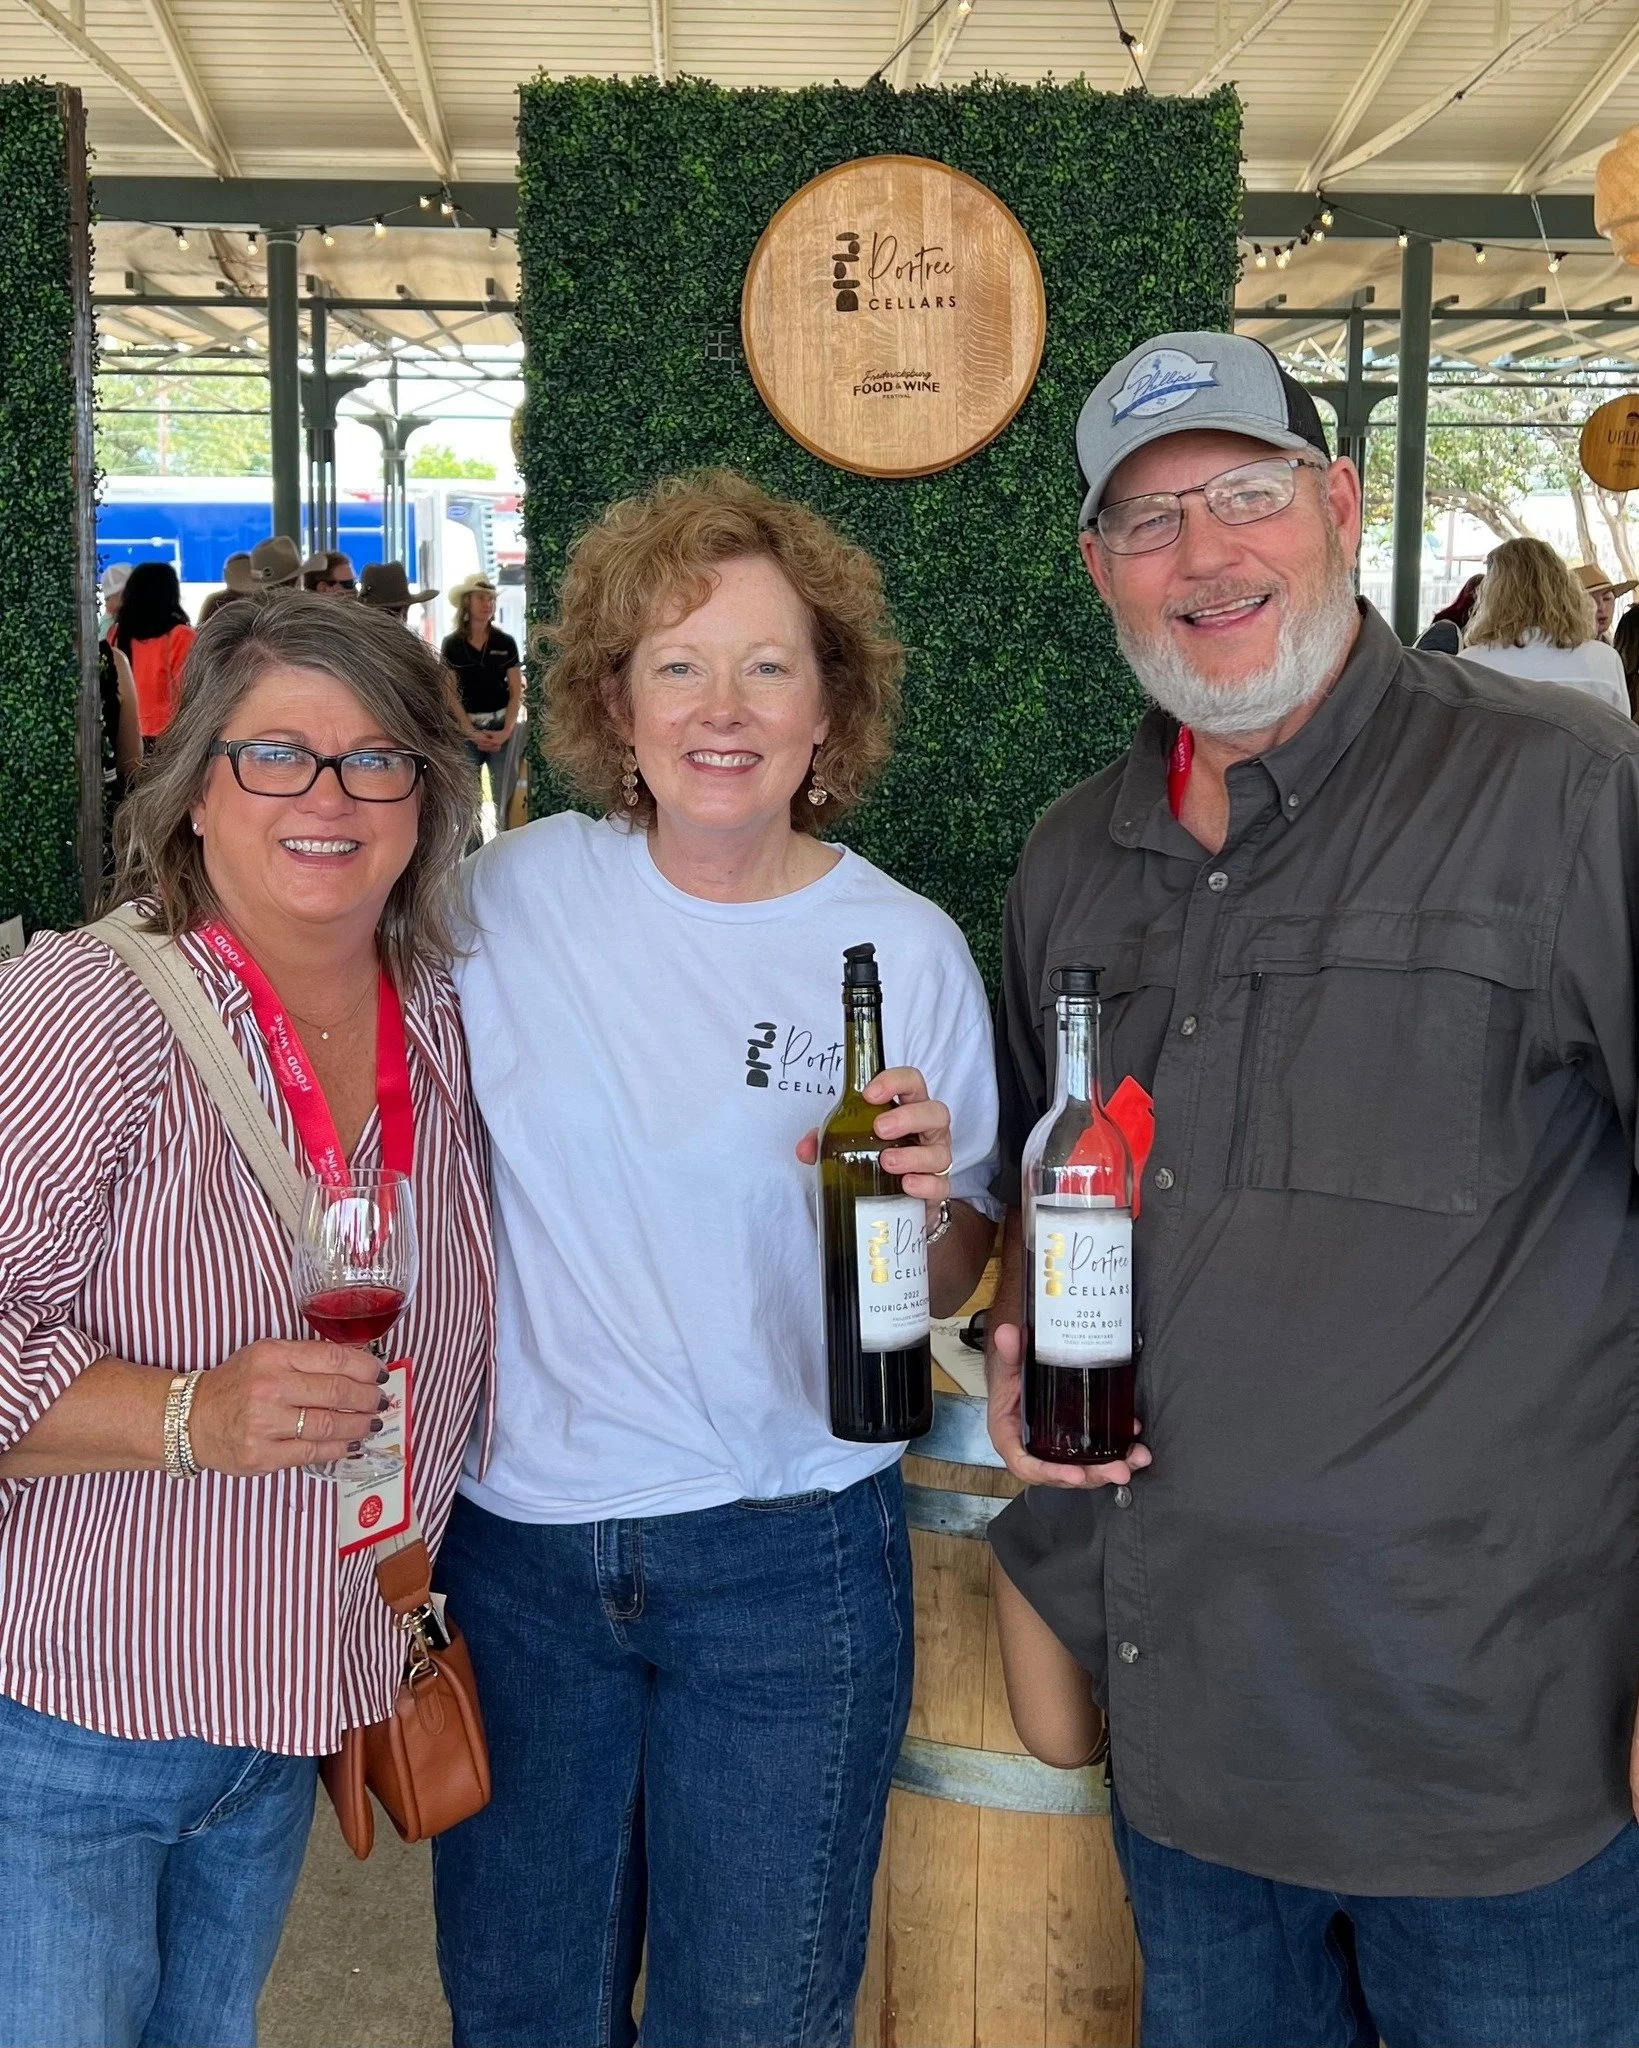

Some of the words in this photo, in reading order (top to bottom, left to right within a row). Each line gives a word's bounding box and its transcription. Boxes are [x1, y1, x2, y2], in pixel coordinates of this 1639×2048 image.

[868, 232, 955, 296] Portree
[869, 296, 956, 310] CELLARS
[853, 382, 893, 396] FOOD
[903, 381, 940, 393] WINE
[1127, 369, 1197, 402] Phillips
[214, 935, 246, 968] FOOD
[274, 1012, 289, 1050] WINE
[287, 1056, 312, 1092] FOOD
[778, 1081, 836, 1096] CELLA
[325, 1145, 341, 1182] WINE
[1069, 1232, 1129, 1284] Portree
[1068, 1285, 1130, 1296] CELLARS
[869, 1303, 908, 1313] TOURIGA
[1076, 1310, 1101, 1318] 2024
[1050, 1318, 1097, 1329] TOURIGA
[1101, 1317, 1123, 1329] ROSÉ
